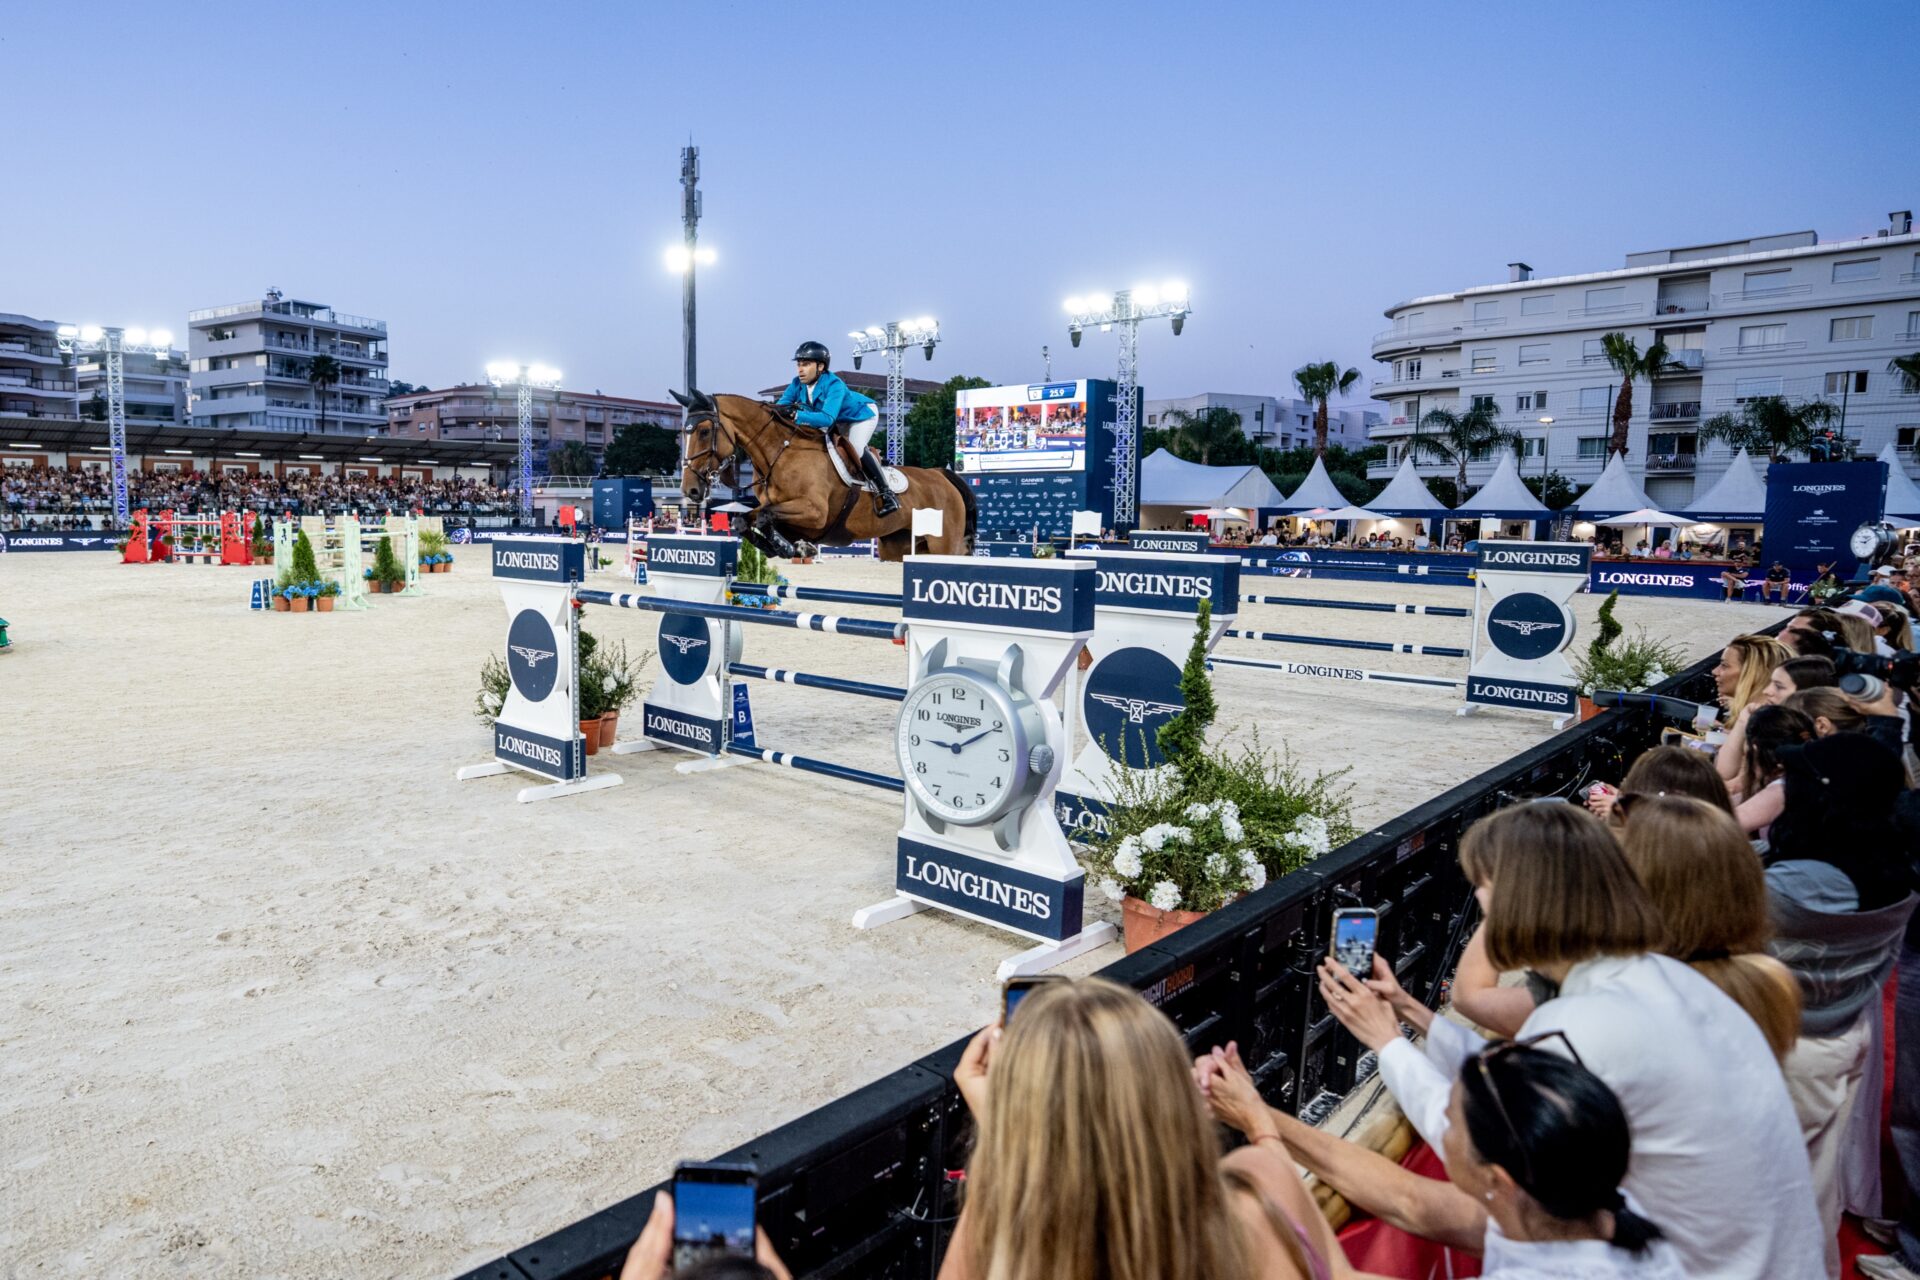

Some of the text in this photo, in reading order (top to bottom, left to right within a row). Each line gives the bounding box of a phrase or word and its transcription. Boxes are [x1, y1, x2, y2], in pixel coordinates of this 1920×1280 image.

[1793, 484, 1846, 492] LONGINES
[9, 537, 64, 546] LONGINES
[995, 532, 1003, 541] 1
[1018, 535, 1027, 544] 3
[1133, 539, 1198, 552] LONGINES
[496, 550, 559, 571] LONGINES
[650, 547, 716, 567] LONGINES
[1483, 550, 1581, 566] LONGINES
[1095, 570, 1213, 599] ONGINES
[1599, 572, 1695, 587] LONGINES
[911, 578, 1062, 614] LONGINES
[1288, 663, 1364, 681] LONGINES
[932, 692, 941, 705] 11
[952, 687, 966, 701] 12
[1473, 683, 1569, 705] LONGINES
[980, 698, 985, 711] 1
[738, 710, 747, 723] B
[917, 709, 931, 721] 10
[936, 712, 982, 727] LONGINES
[647, 713, 712, 743] LONGINES
[992, 720, 1003, 733] 2
[911, 734, 921, 747] 9
[498, 733, 562, 767] LONGINES
[998, 748, 1010, 763] 3
[916, 761, 927, 774] 8
[990, 776, 1003, 789] 4
[932, 783, 942, 797] 7
[952, 795, 964, 809] 6
[975, 792, 986, 806] 5
[906, 855, 1051, 920] LONGINES
